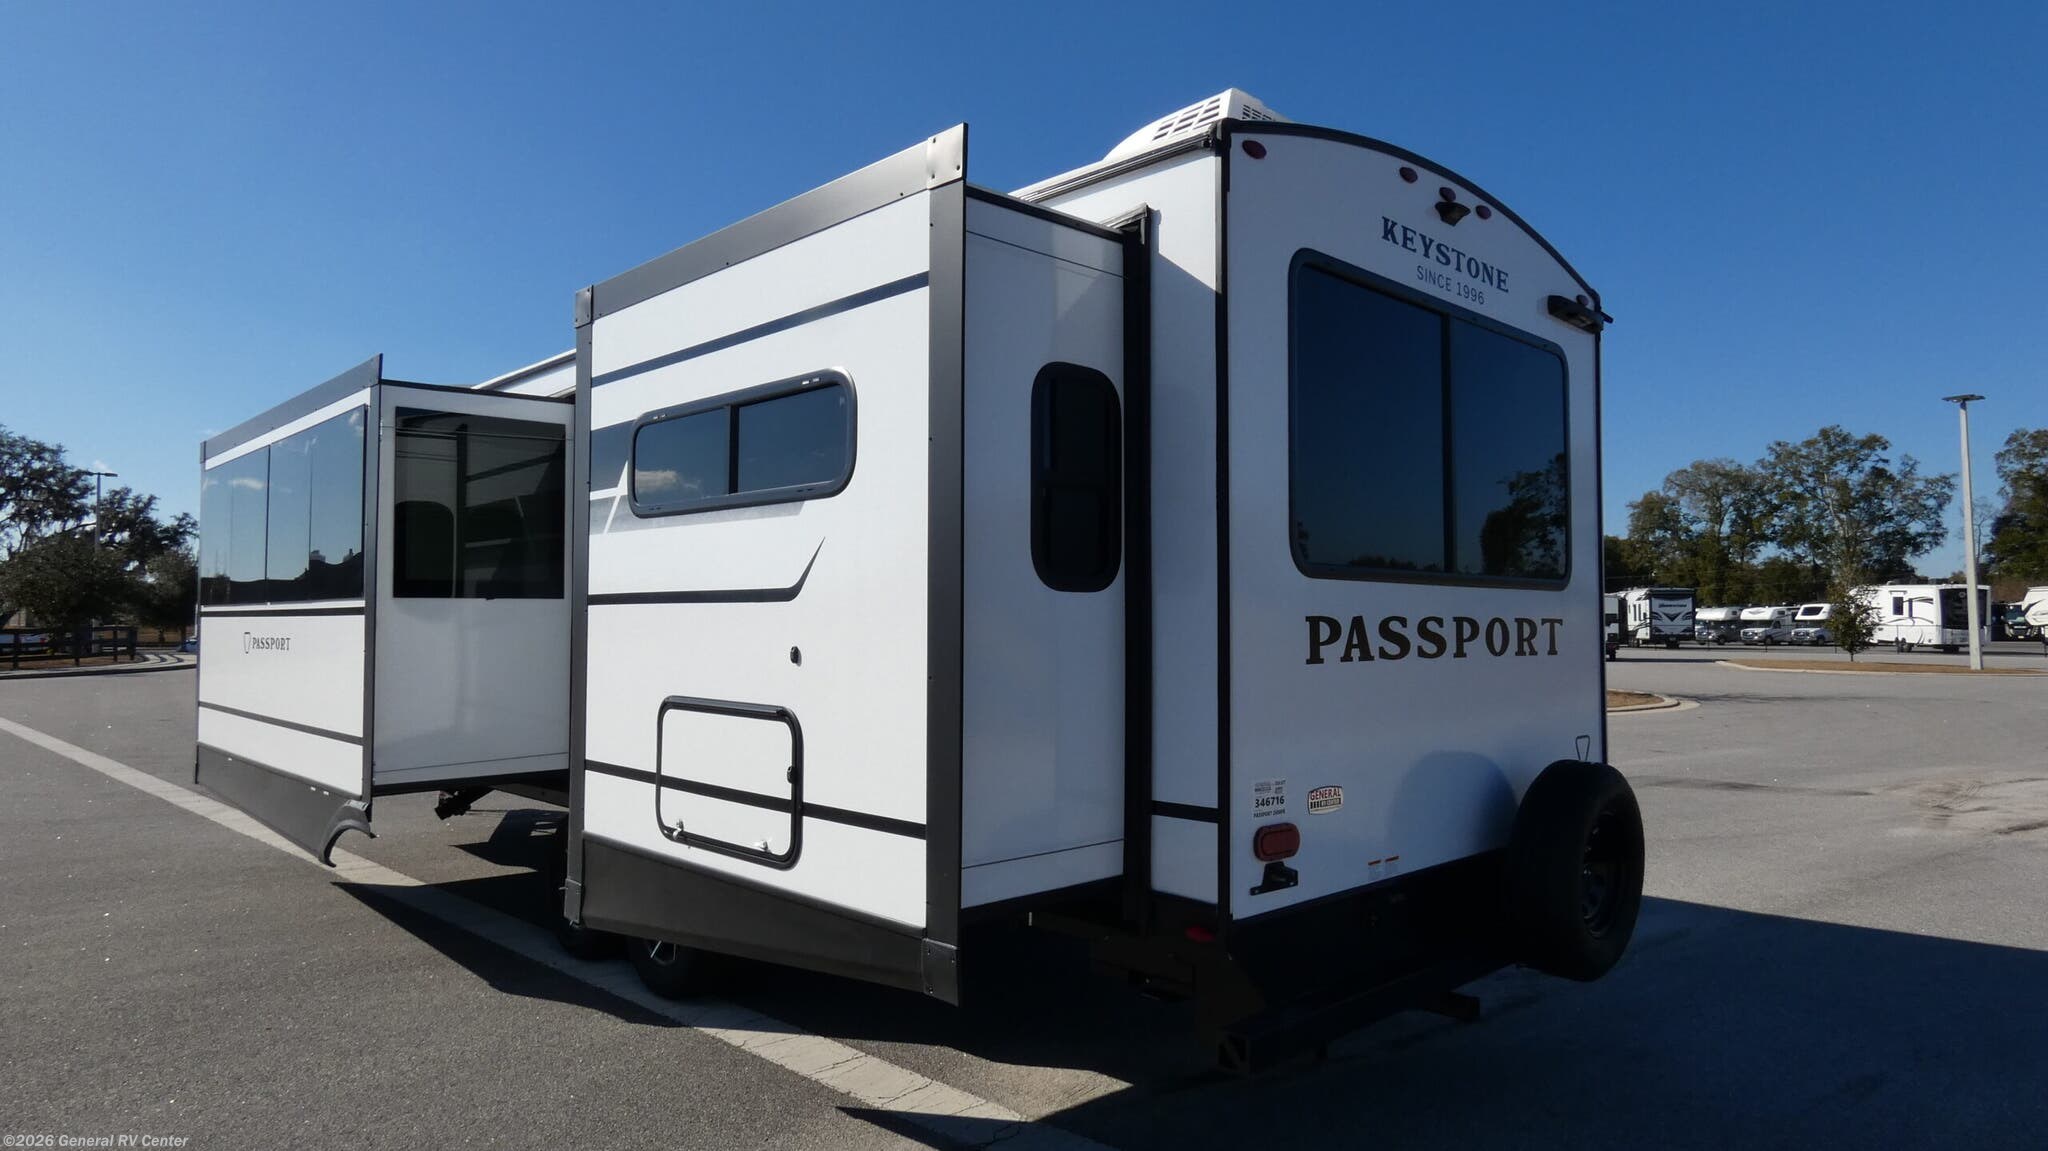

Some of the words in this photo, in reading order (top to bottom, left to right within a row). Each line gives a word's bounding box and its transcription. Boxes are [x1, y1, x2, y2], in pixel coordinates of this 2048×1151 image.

[1381, 216, 1509, 294] KEYSTONE
[1416, 265, 1452, 292] SINCE
[1456, 281, 1485, 305] 1996
[252, 637, 290, 650] PASSPORT
[1305, 615, 1563, 665] PASSPORT
[1255, 796, 1284, 808] 346716
[1310, 788, 1341, 801] GENERAL
